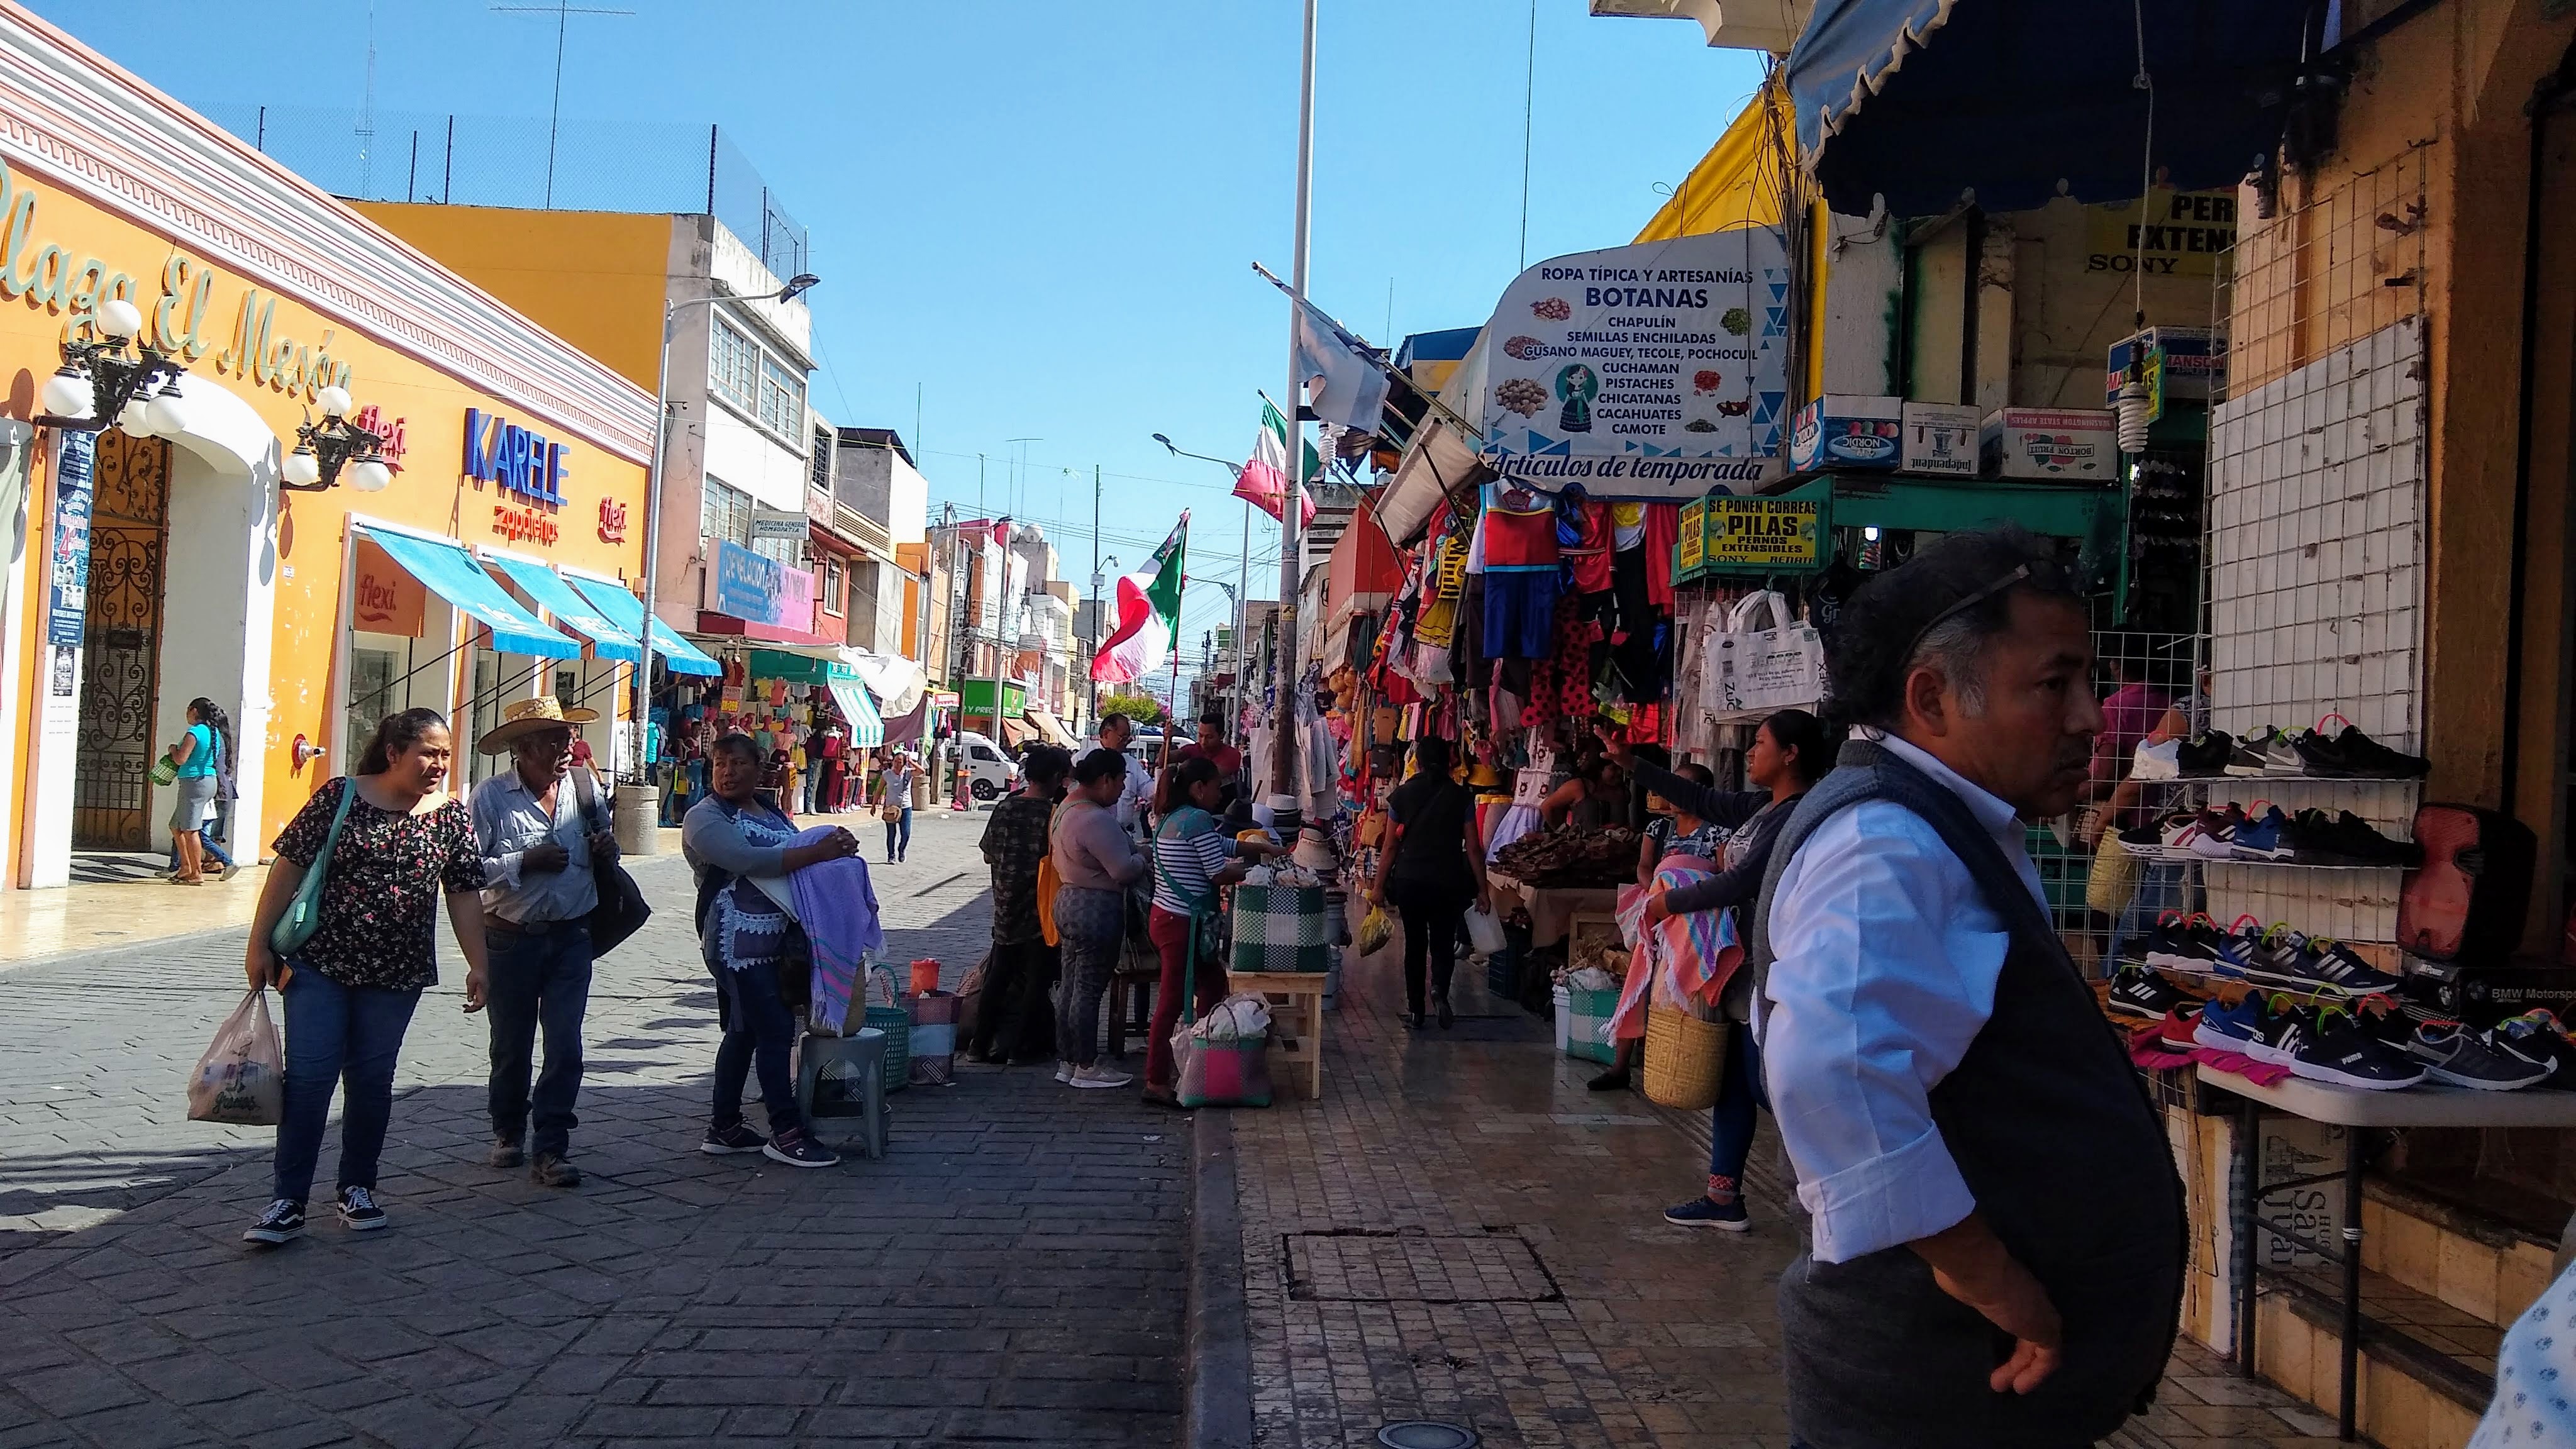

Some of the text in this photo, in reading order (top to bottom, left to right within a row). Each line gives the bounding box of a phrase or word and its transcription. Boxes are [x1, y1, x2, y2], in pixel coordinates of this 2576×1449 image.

[2172, 195, 2235, 221] PER
[2128, 225, 2236, 252] EXTEN
[2089, 254, 2178, 274] SONY
[0, 159, 352, 395] laza El Mesón
[1541, 265, 1753, 284] ROPA TÍPICA Y ARTESANÍAS
[1585, 288, 1708, 308] BOTANAS
[1608, 314, 1675, 328] CHAPULÍN
[1567, 331, 1716, 344] SEMILLAS ENCHILADAS
[1524, 346, 1758, 360] GUSANO MAGUEY, TECOLE, POCHOCUIL
[1602, 363, 1679, 374] CUCHAMAN
[1606, 379, 1674, 389] PISTACHES
[1598, 394, 1681, 404] CHICATANAS
[1597, 409, 1682, 420] CACAHUATES
[2011, 416, 2110, 428] WASHINGTON STATE APPLES
[1612, 424, 1666, 435] CAMOTE
[1842, 437, 1880, 448] NORDIC
[467, 408, 570, 506] KARELE
[2029, 445, 2092, 455] BORTON FRUIT
[1597, 457, 1626, 477] de
[1631, 458, 1763, 486] temporada
[1911, 458, 1971, 472] Independent
[602, 496, 626, 530] flexi
[1709, 500, 1816, 514] SE PONEN CORREAS
[1685, 518, 1701, 543] PILAS
[1728, 515, 1797, 536] PILAS
[1737, 536, 1787, 545] PERNOS
[1722, 544, 1802, 553] EXTENSIBLES
[1708, 555, 1748, 563] SONY
[360, 573, 397, 611] flexi
[2492, 988, 2523, 999] BMW
[2341, 1052, 2363, 1065] PUMA
[2294, 1190, 2326, 1257] San
